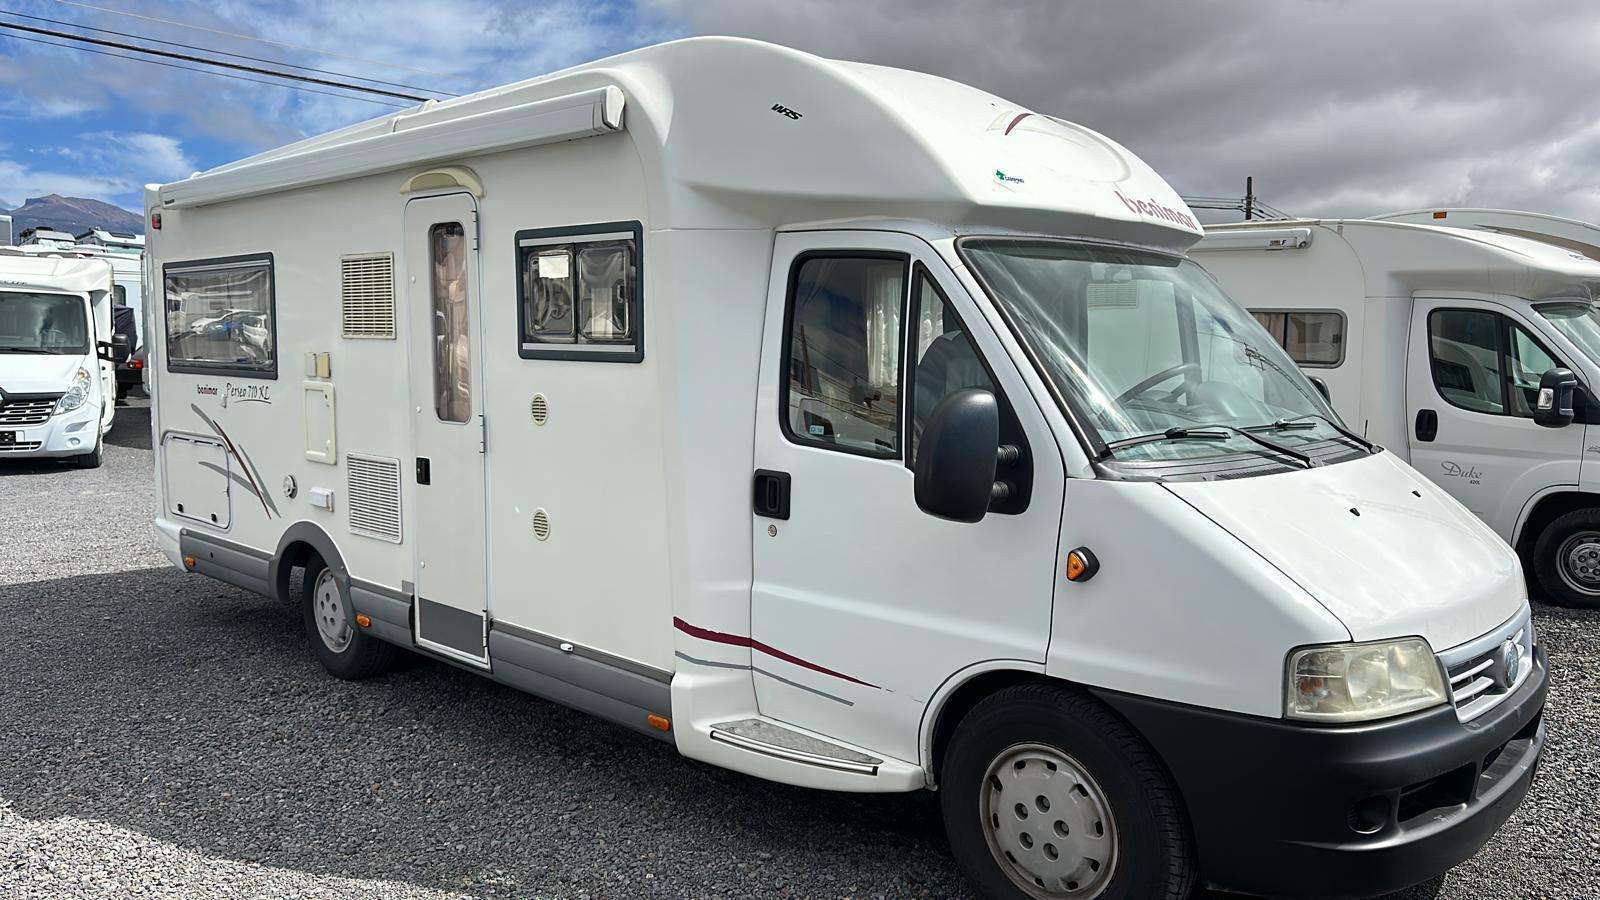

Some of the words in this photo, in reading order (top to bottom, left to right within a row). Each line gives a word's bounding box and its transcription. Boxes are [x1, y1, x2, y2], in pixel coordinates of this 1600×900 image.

[1113, 190, 1198, 231] benimar
[197, 384, 218, 396] benimar
[225, 382, 247, 398] Perseo
[1440, 460, 1483, 479] Duke
